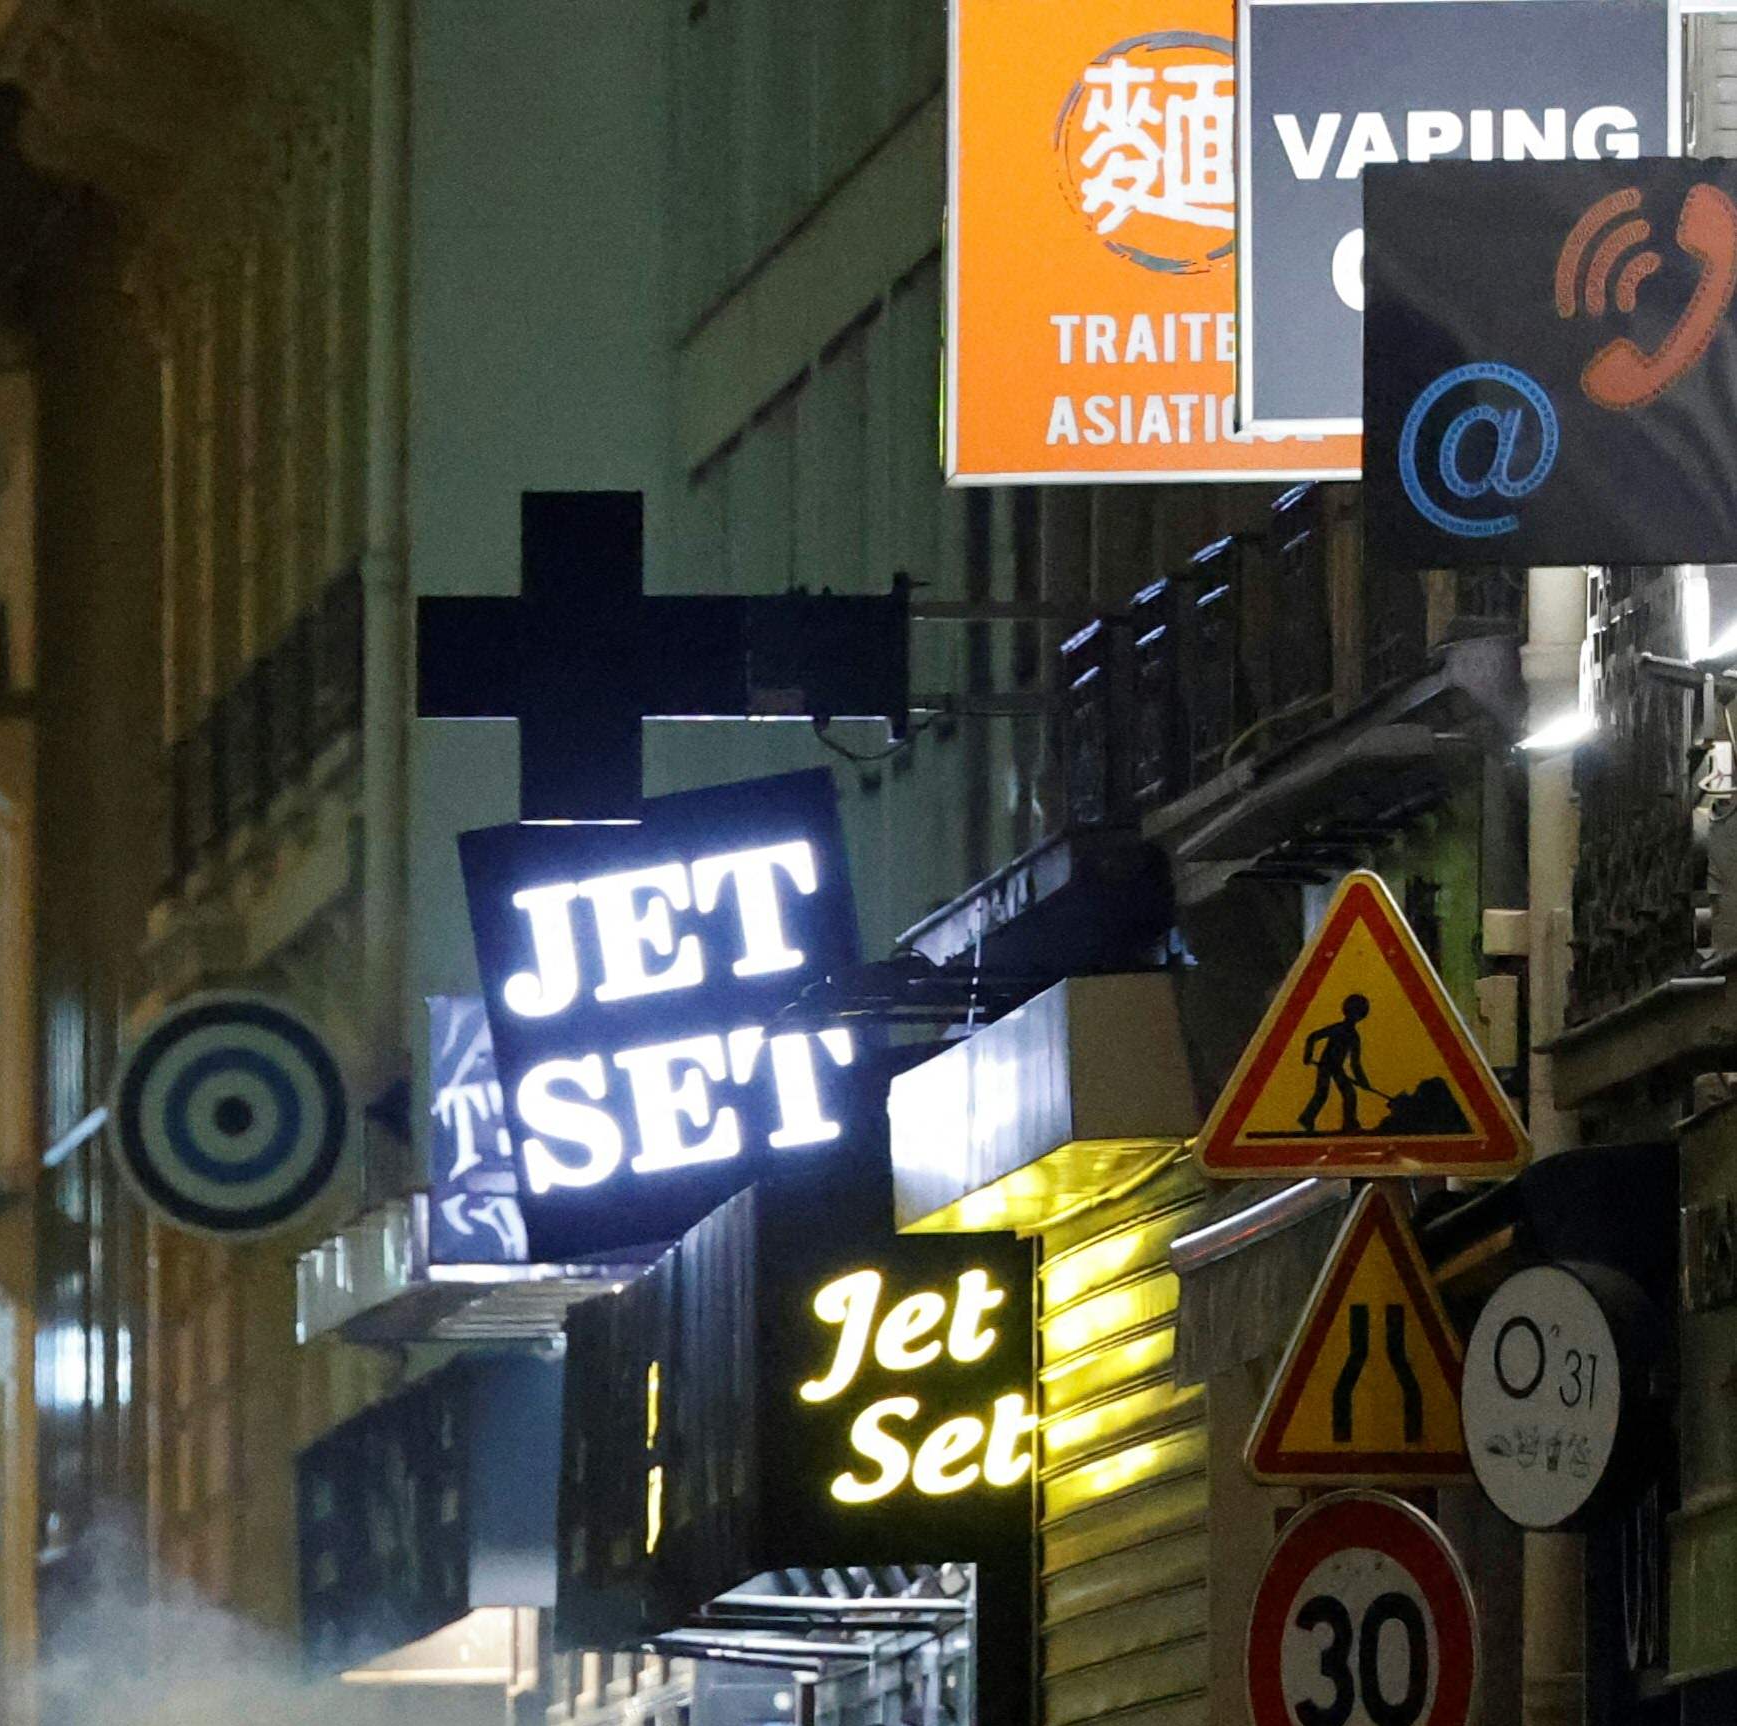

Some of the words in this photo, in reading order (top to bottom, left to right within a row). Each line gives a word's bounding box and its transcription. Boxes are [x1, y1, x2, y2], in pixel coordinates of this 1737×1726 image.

[1272, 105, 1640, 180] VAPING
[1045, 393, 1324, 446] ASIATI
[503, 840, 818, 1018] JET
[517, 1026, 854, 1195] SET
[799, 1269, 1005, 1402] Jet
[830, 1393, 1041, 1504] Set
